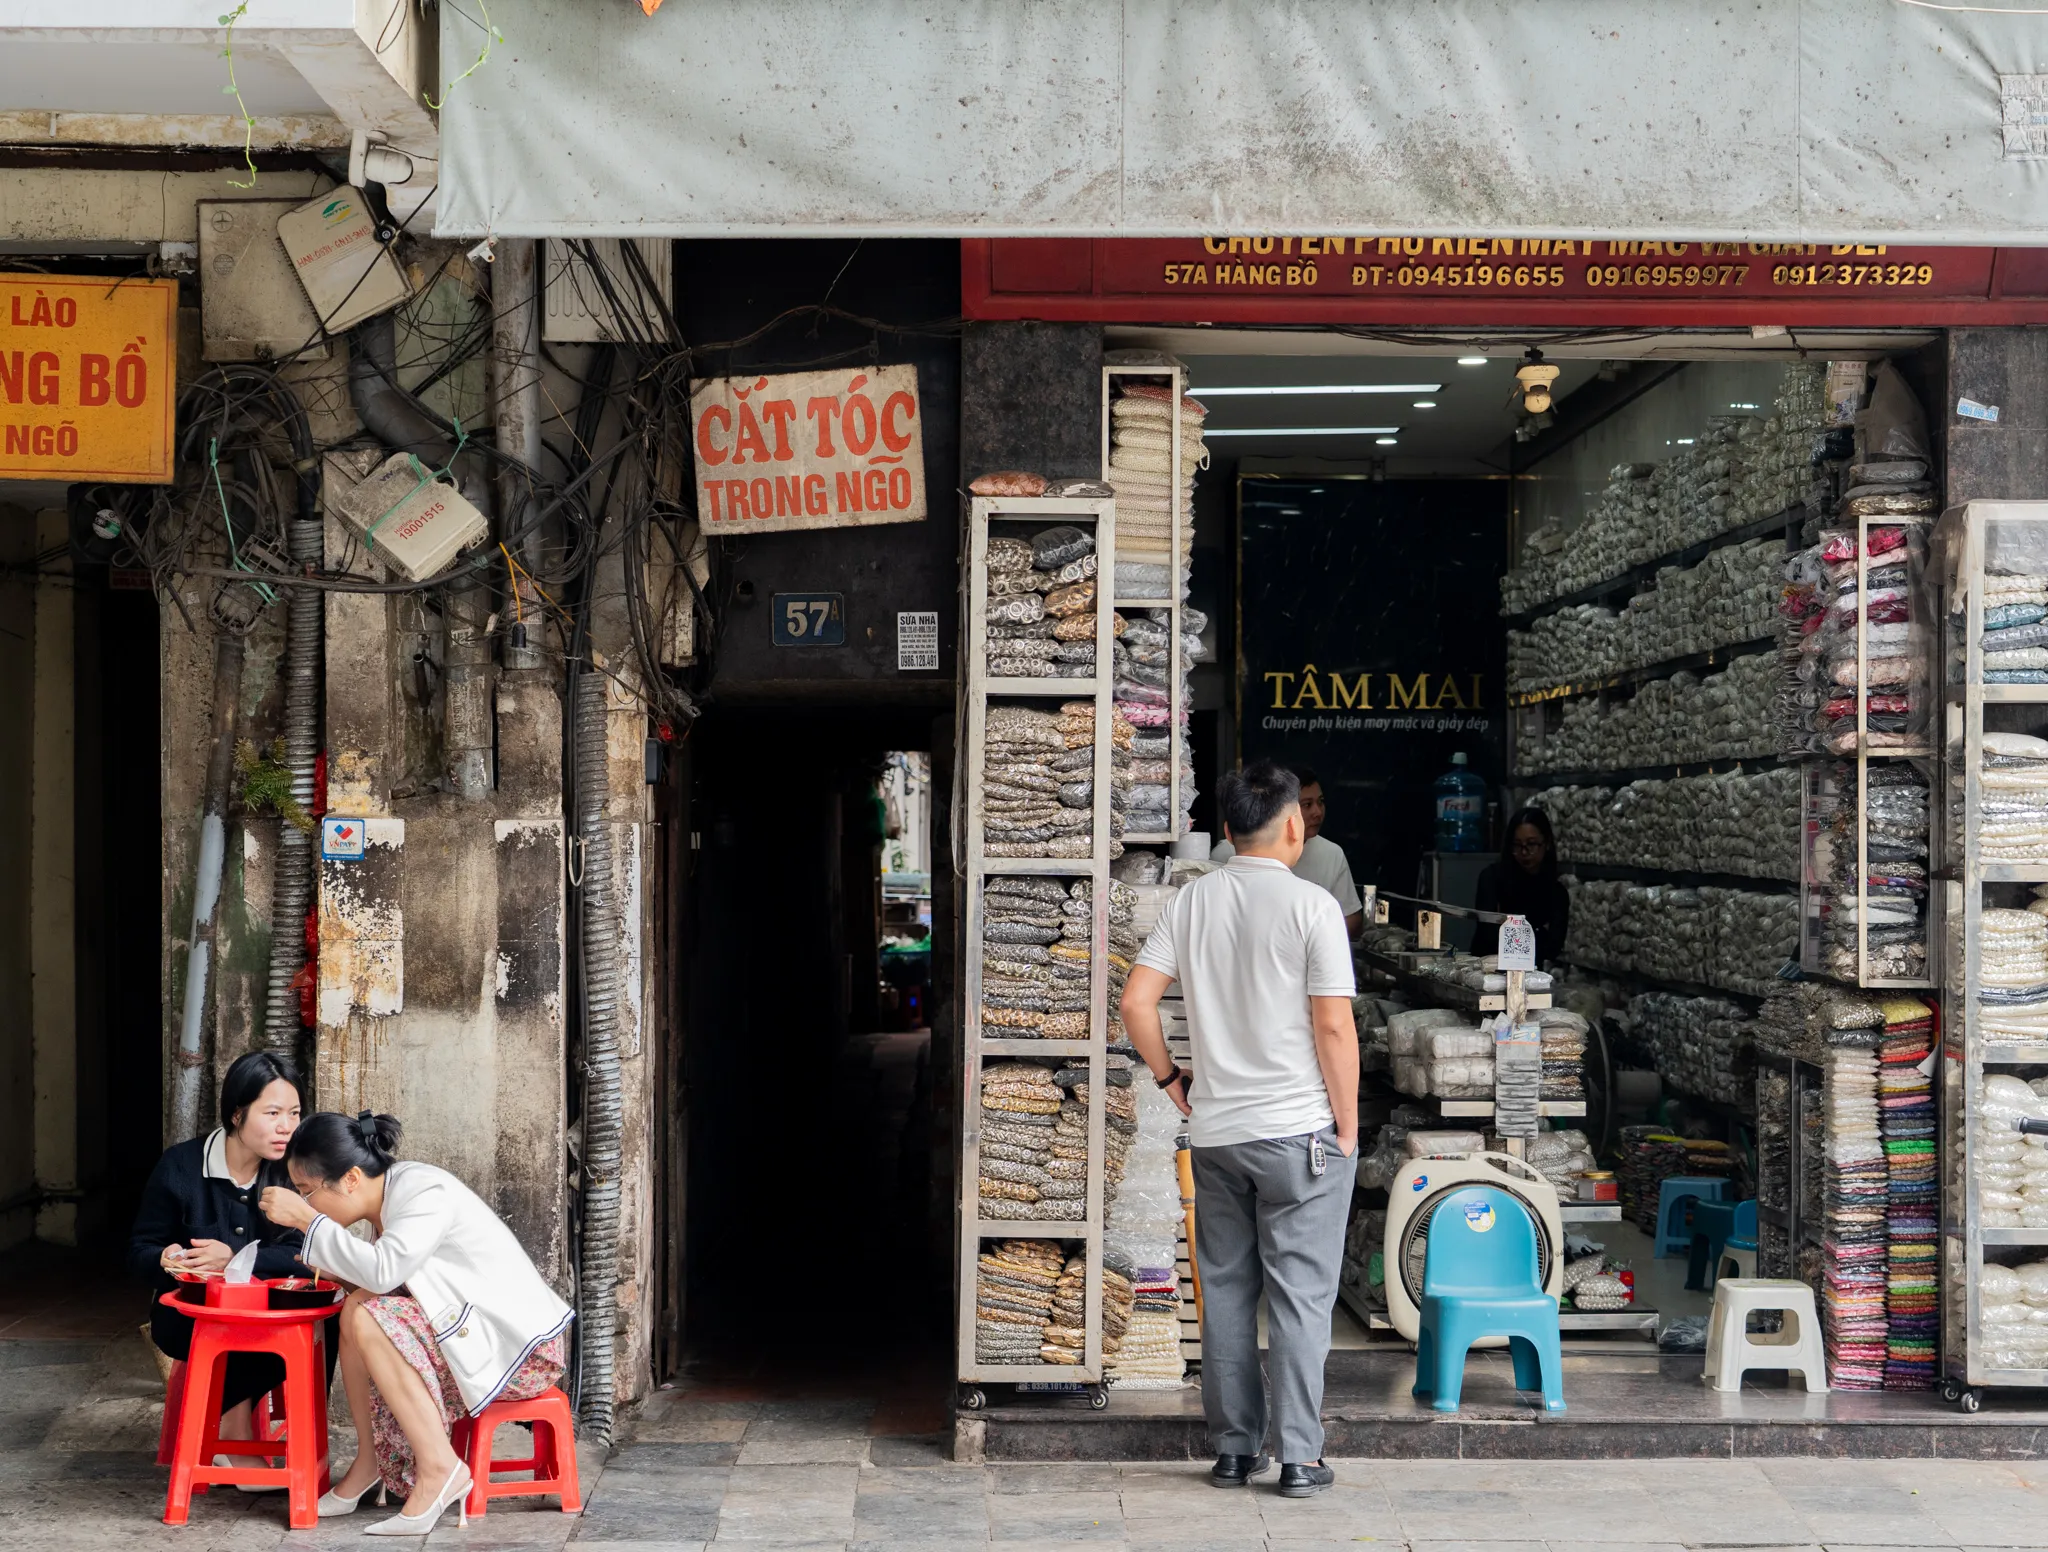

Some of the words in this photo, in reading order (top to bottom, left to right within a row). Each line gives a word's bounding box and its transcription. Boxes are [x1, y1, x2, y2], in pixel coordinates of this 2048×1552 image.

[1164, 264, 1208, 284] 57A
[1215, 258, 1281, 285] HÀNG
[1286, 258, 1318, 286] BỒ
[1586, 265, 1750, 287] 0916959977
[1772, 265, 1933, 286] 0912373329
[11, 290, 77, 328] LÀO
[79, 336, 148, 409] BỒ
[5, 420, 79, 457] NGÕ
[697, 376, 797, 467] CẮT
[806, 374, 916, 458] TÓC
[703, 472, 829, 522] TRONG
[835, 455, 912, 513] NGÕ
[394, 519, 413, 534] Hotline
[399, 502, 445, 540] 19001515
[900, 613, 916, 625] SỬA
[919, 614, 936, 625] NHÀ
[1264, 663, 1373, 709] TÂM
[1385, 672, 1485, 709] MAI
[1262, 715, 1307, 732] Chuyên
[1308, 715, 1333, 732] phụ
[1335, 715, 1362, 731] kiện
[1364, 717, 1391, 732] may
[1421, 716, 1435, 729] và
[1466, 716, 1489, 733] dép
